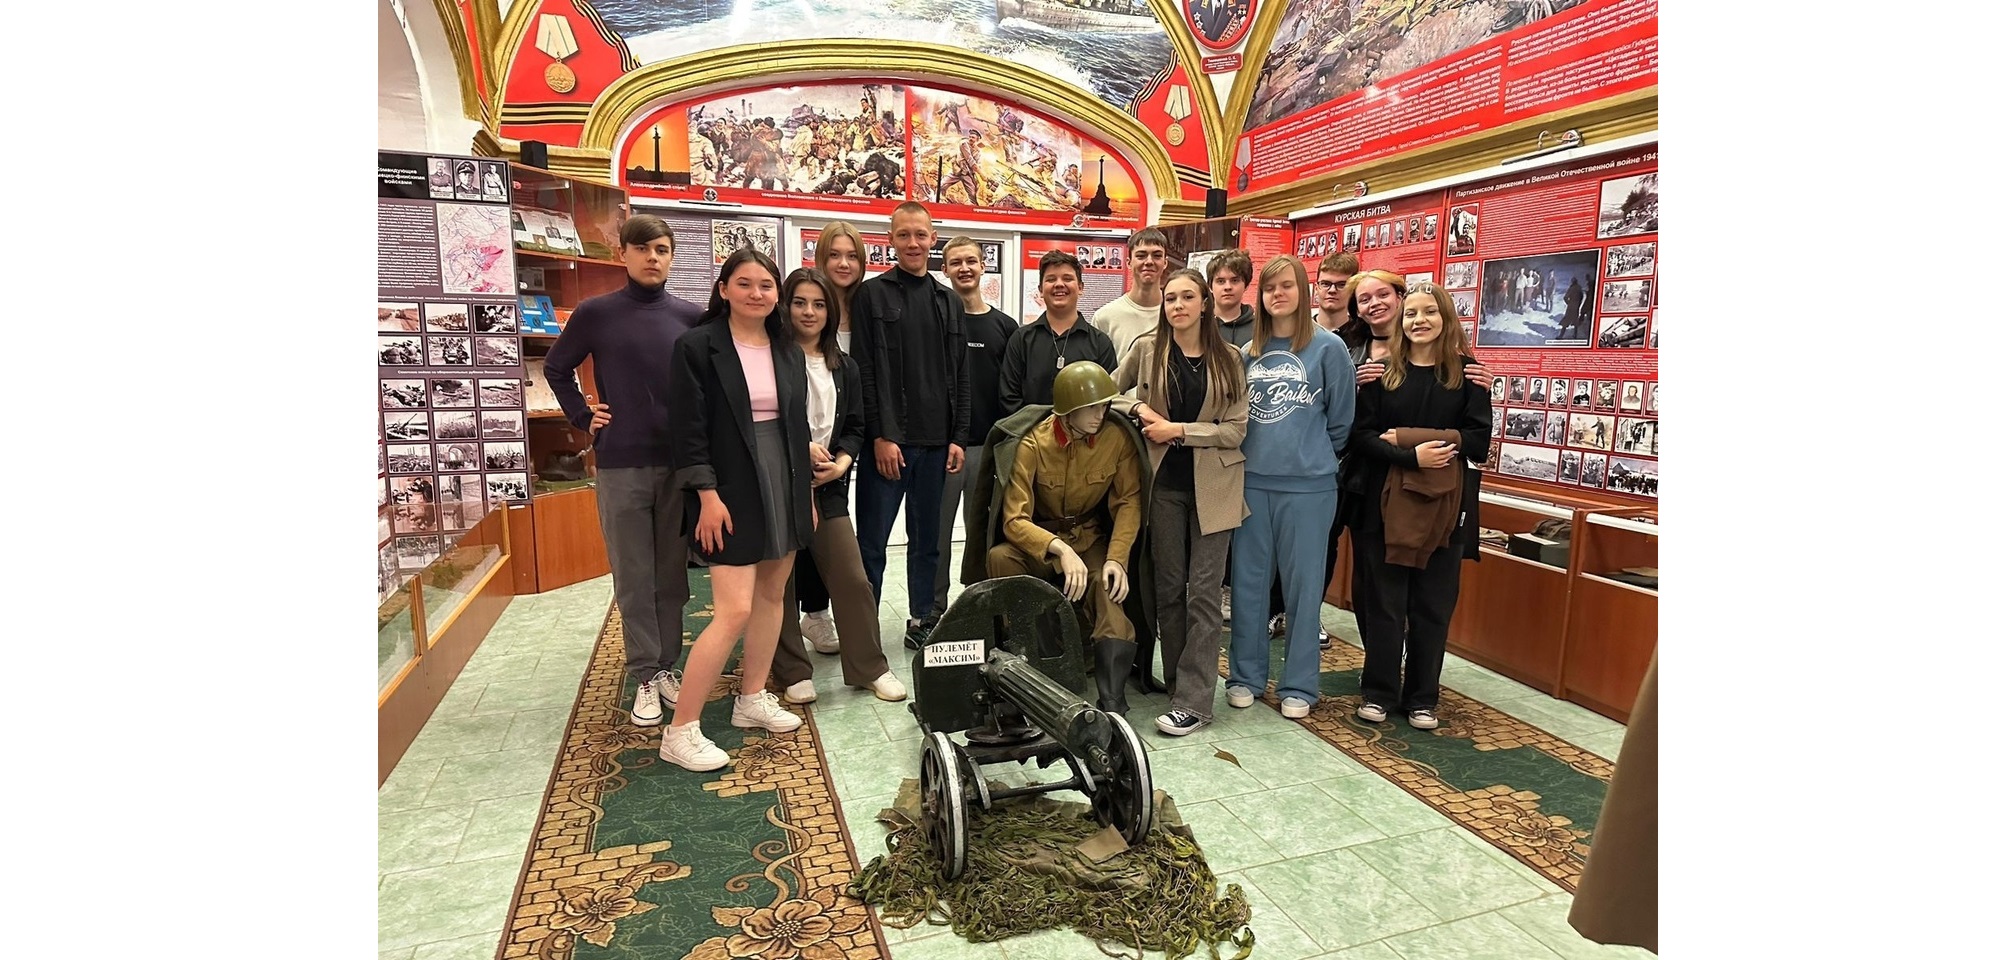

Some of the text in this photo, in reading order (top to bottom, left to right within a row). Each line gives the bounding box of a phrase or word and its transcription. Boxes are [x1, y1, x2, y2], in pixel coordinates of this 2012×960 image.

[1456, 185, 1494, 198] Партизанское
[1495, 179, 1524, 191] движение
[1532, 170, 1559, 183] Великой
[1561, 160, 1615, 178] Отечественной
[1617, 157, 1640, 167] войне
[1335, 209, 1365, 223] КУРСКАЯ
[1366, 204, 1391, 218] БИТВА
[1248, 384, 1264, 404] ke
[931, 642, 977, 653] ПУЛЕМЁТ
[929, 654, 980, 664] «МАКСИМ»
